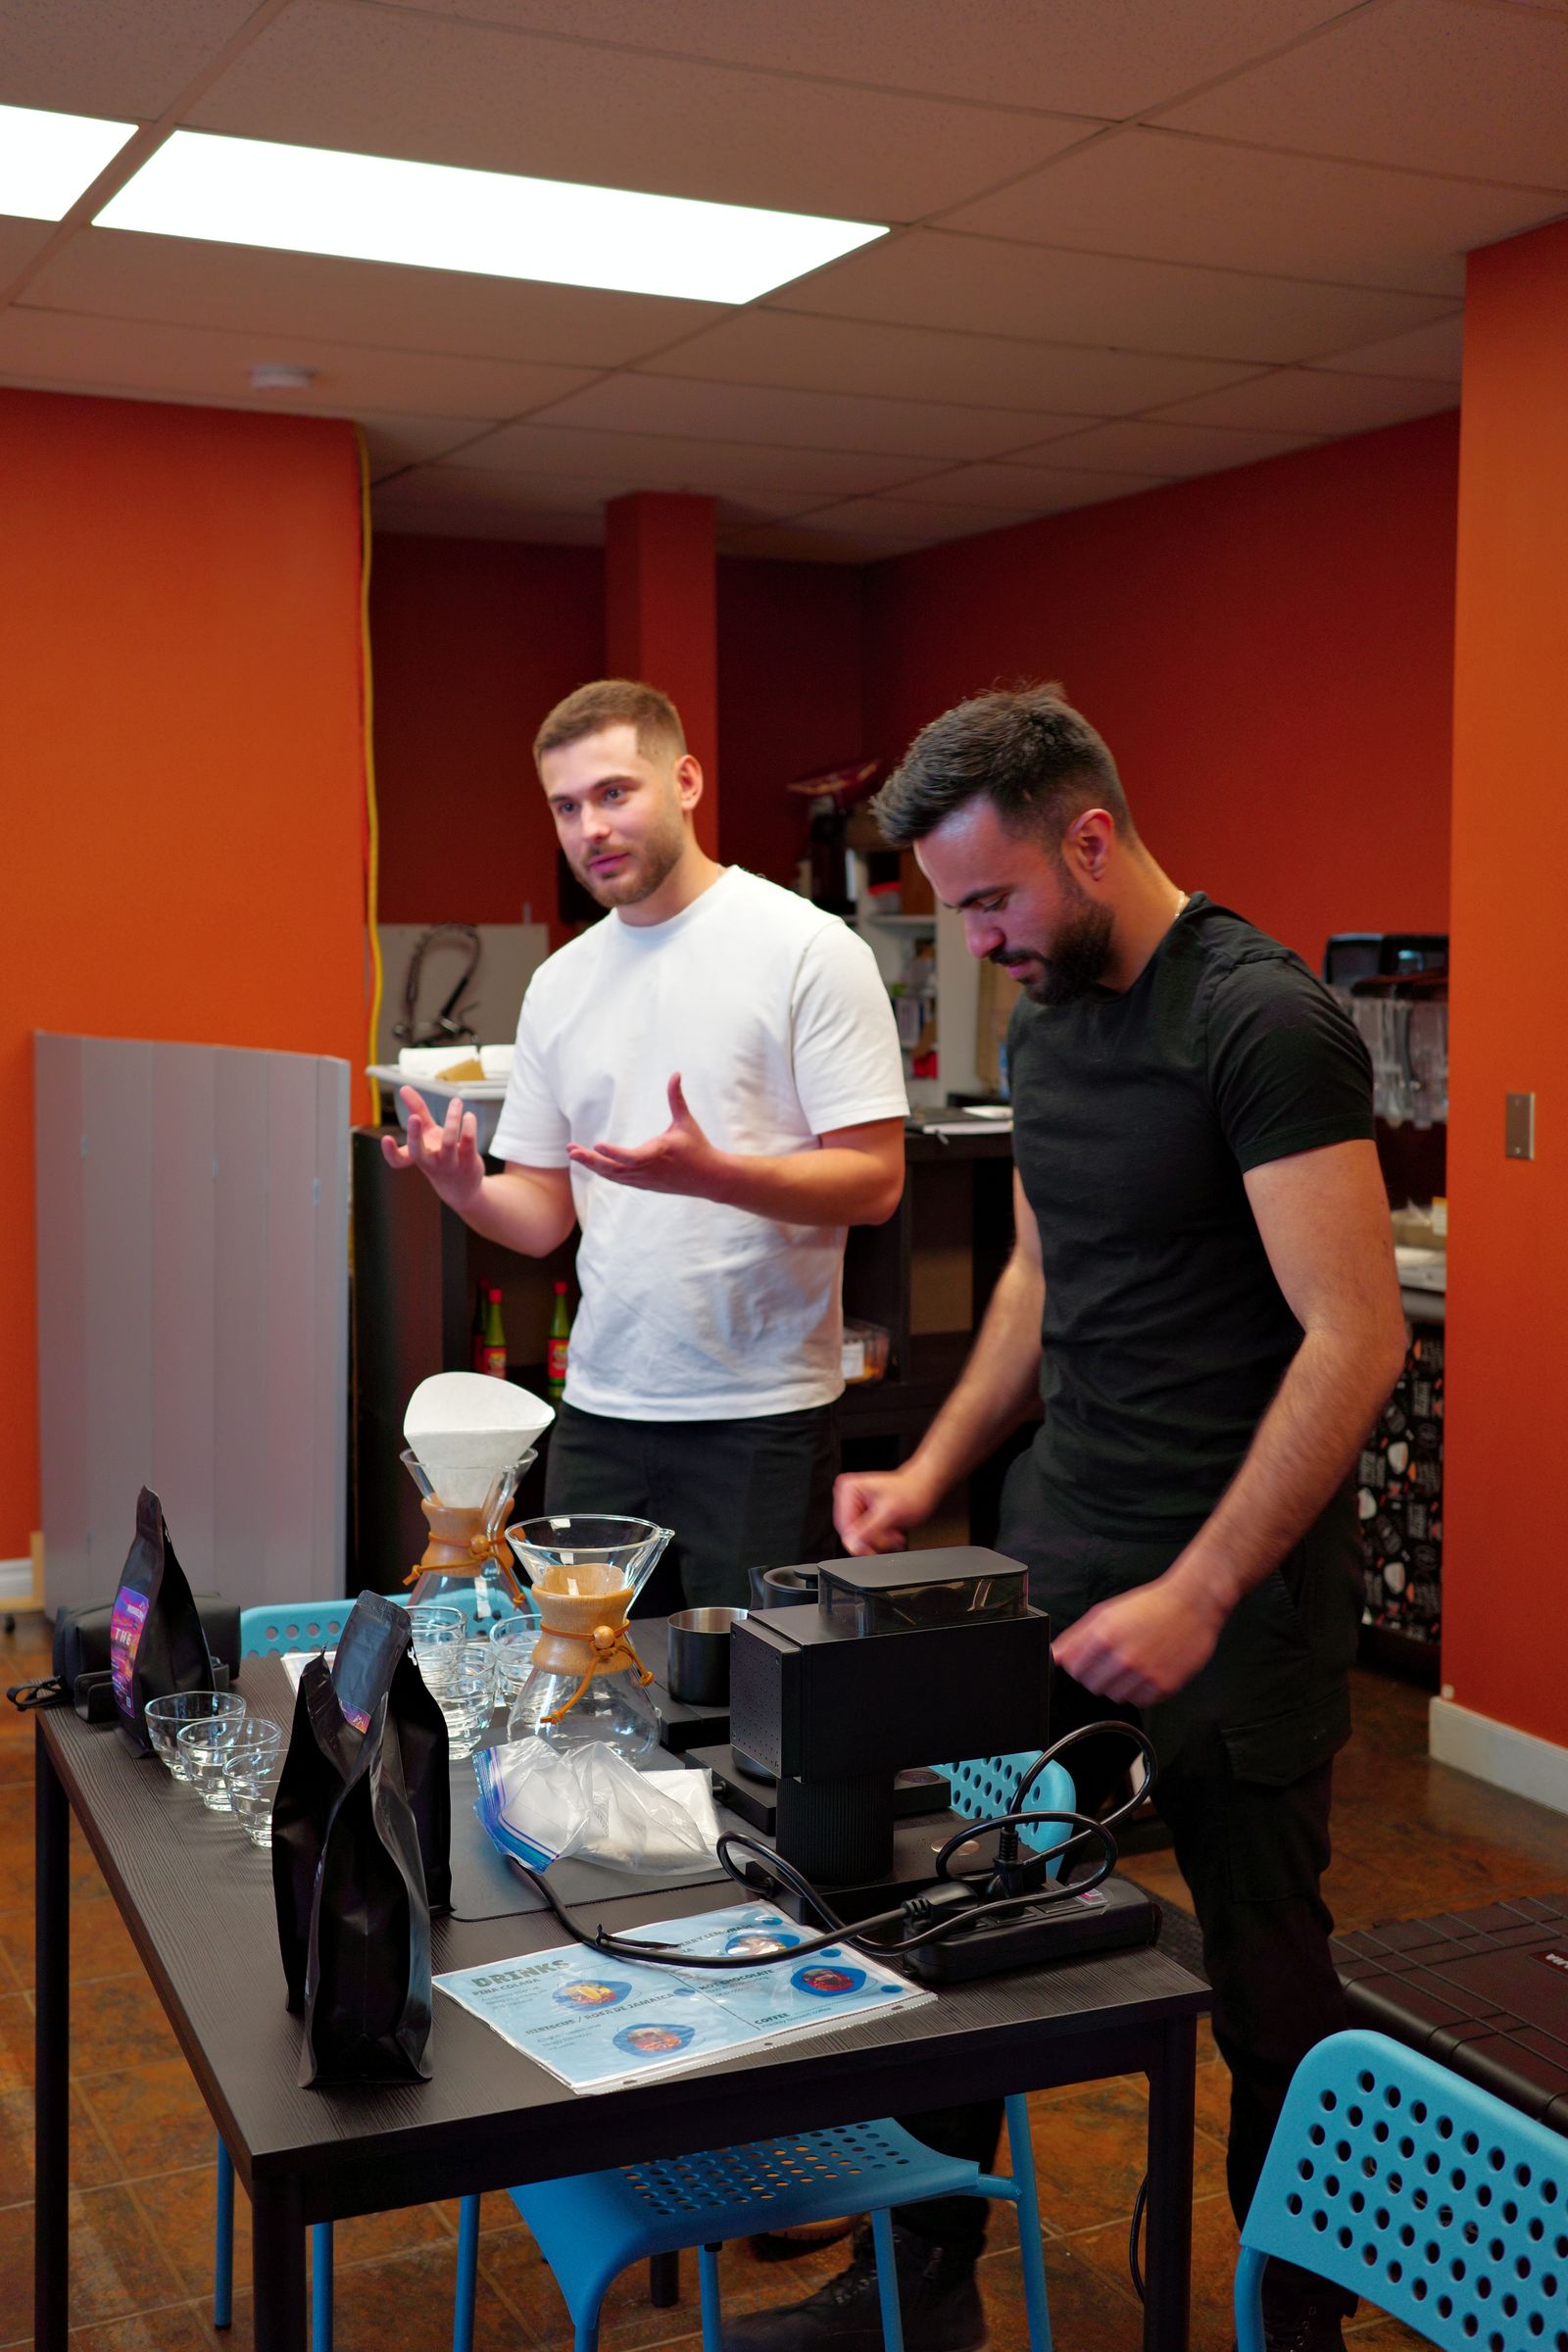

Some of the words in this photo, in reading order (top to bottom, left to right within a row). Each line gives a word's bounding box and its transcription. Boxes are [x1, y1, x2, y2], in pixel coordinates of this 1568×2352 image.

[115, 1628, 132, 1645] THE
[470, 1959, 571, 1987] DRINKS
[698, 1982, 719, 1990] HOT
[720, 1969, 774, 1985] CHOCOLATE
[501, 1978, 541, 1991] COLADA
[525, 2018, 576, 2035] HIBISCUS
[584, 2008, 612, 2021] ROSA
[627, 1992, 675, 2011] JAMAICA
[755, 2012, 792, 2025] COFFEE
